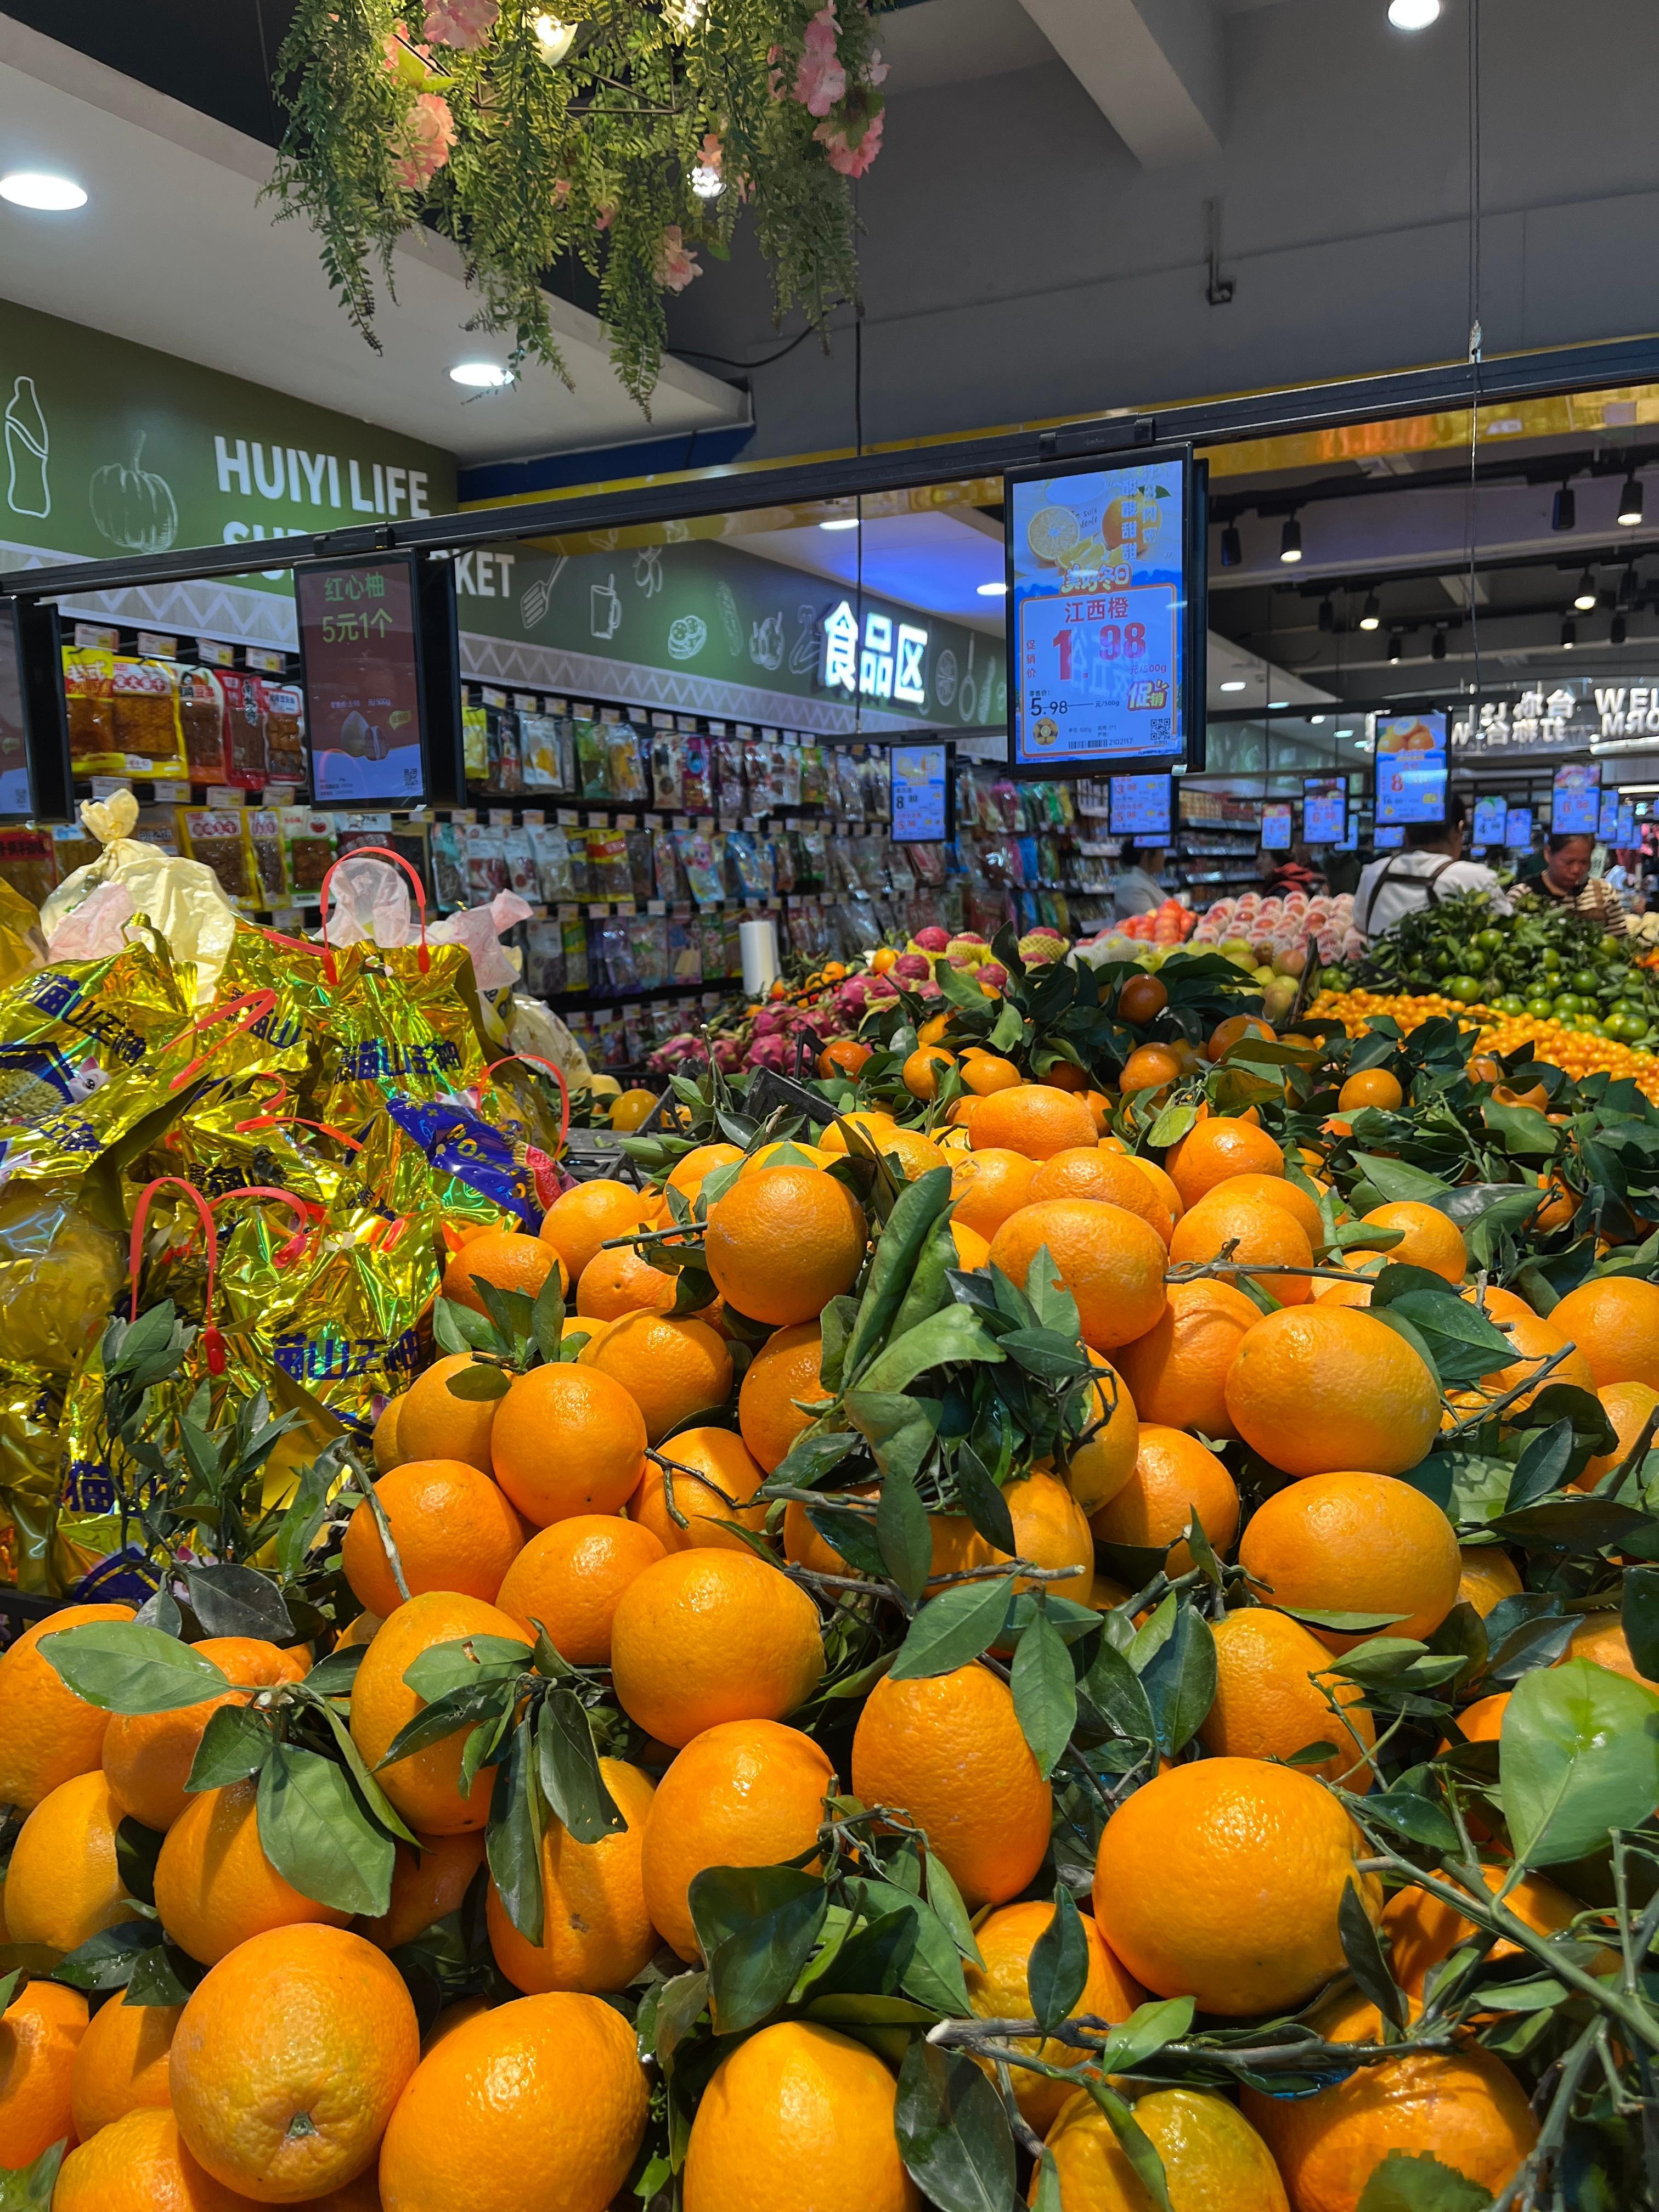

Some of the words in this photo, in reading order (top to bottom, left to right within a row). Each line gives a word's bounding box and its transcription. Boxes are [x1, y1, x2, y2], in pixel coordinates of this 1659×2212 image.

[215, 436, 341, 507] HUIYI
[349, 459, 430, 518] LIFE
[325, 572, 385, 601] 红心柚
[323, 608, 392, 642] 5元1个
[1065, 597, 1129, 623] 江西橙
[825, 601, 928, 704] 食品区
[1026, 640, 1036, 679] 促销价
[1130, 664, 1167, 675] 元/500g
[1031, 697, 1068, 716] 5.98
[1128, 680, 1167, 710] 促销
